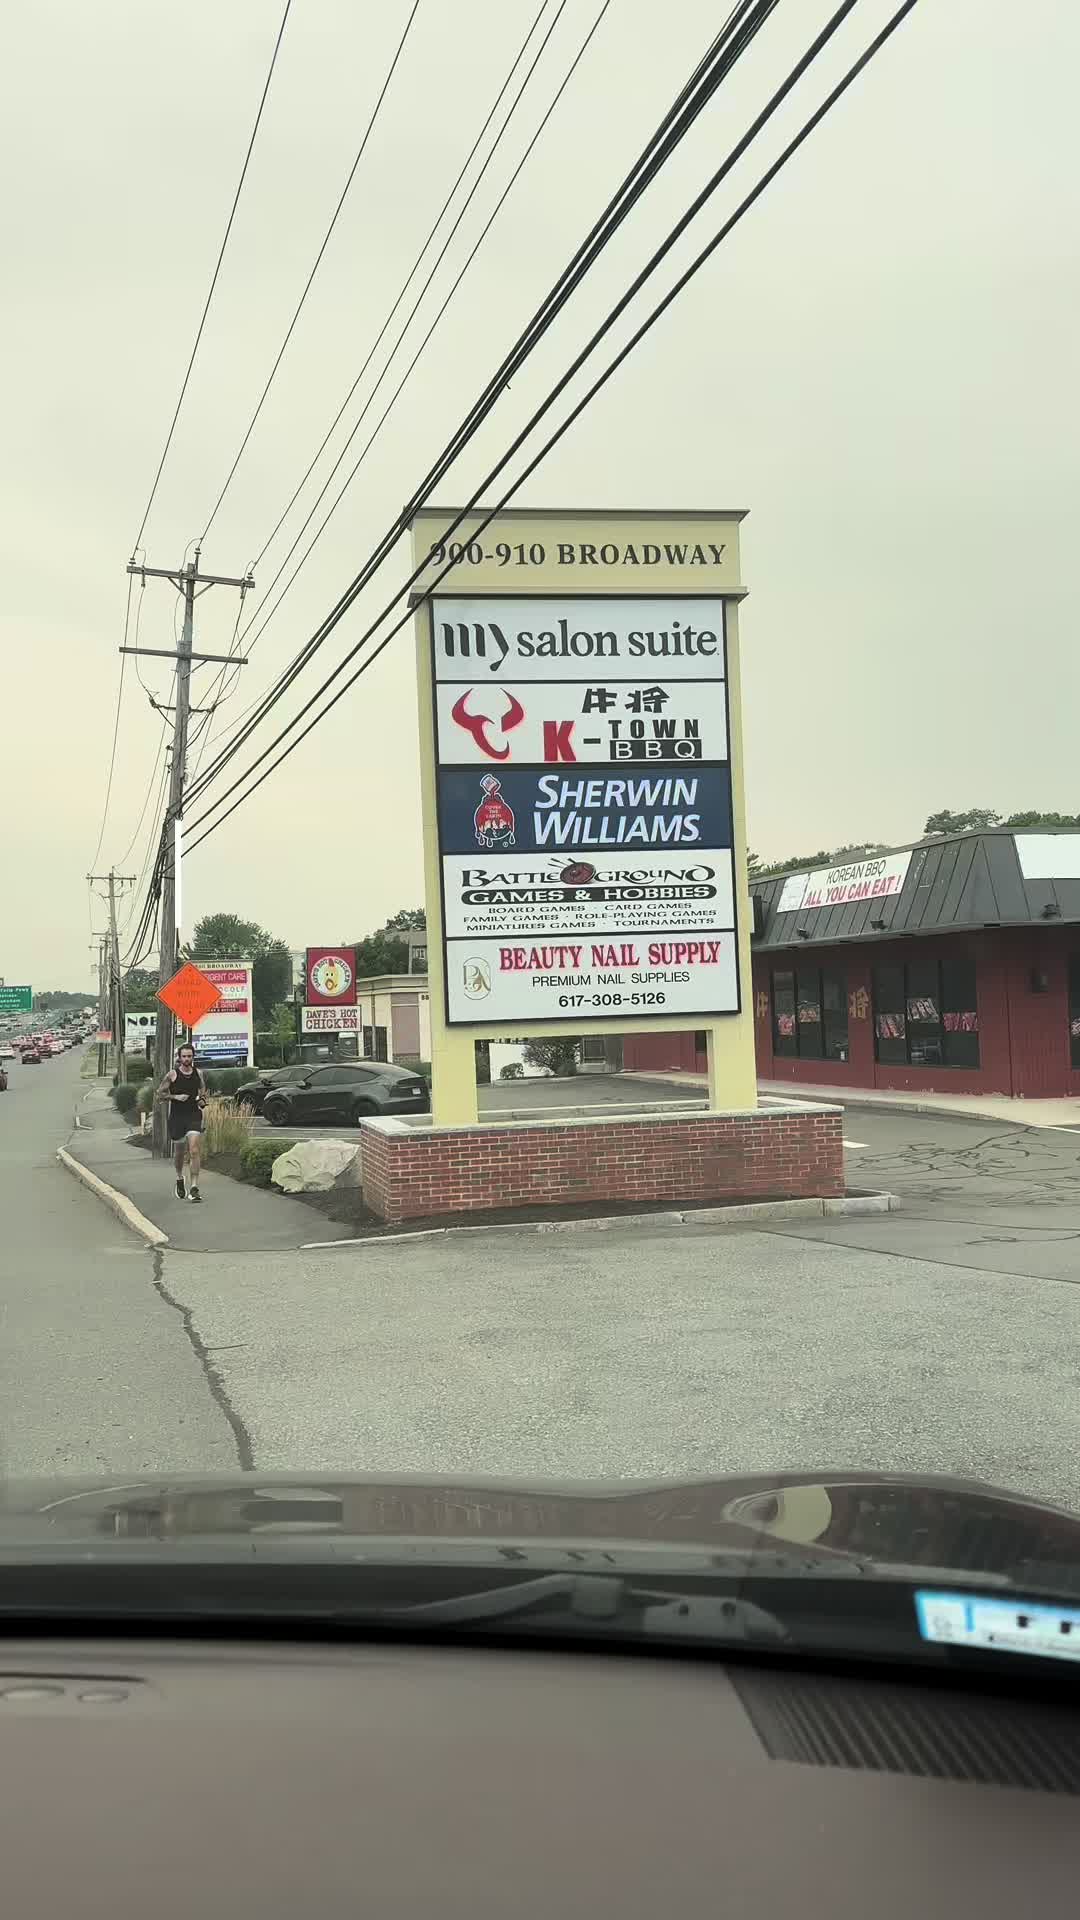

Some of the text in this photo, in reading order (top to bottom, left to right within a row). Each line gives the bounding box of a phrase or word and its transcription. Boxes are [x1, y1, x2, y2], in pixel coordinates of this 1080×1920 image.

[429, 543, 727, 567] 900-910 BROADWAY
[440, 623, 510, 672] my
[516, 619, 621, 657] salon
[615, 740, 696, 760] BBQ
[534, 774, 698, 809] SHERWIN
[533, 811, 701, 845] WILLIAMS
[827, 859, 887, 885] KOREAN BBQ
[469, 886, 711, 903] GAMES & HOBBIES
[804, 890, 822, 907] ALL
[826, 884, 847, 901] YOU
[848, 880, 869, 898] CAN
[871, 876, 895, 894] EAT
[466, 918, 715, 931] MINIATURES GAMES TOURNAMENTS
[575, 911, 668, 920] ROLE-PLAYING
[500, 941, 721, 970] BEAUTY NAIL SUPPLY
[228, 972, 246, 980] CARE
[532, 971, 690, 987] PREMIUM NAIL SUPPLIES
[558, 992, 666, 1007] 617-308-5126
[306, 1008, 358, 1018] DAVE'S HOT
[306, 1019, 357, 1029] CHICKEN
